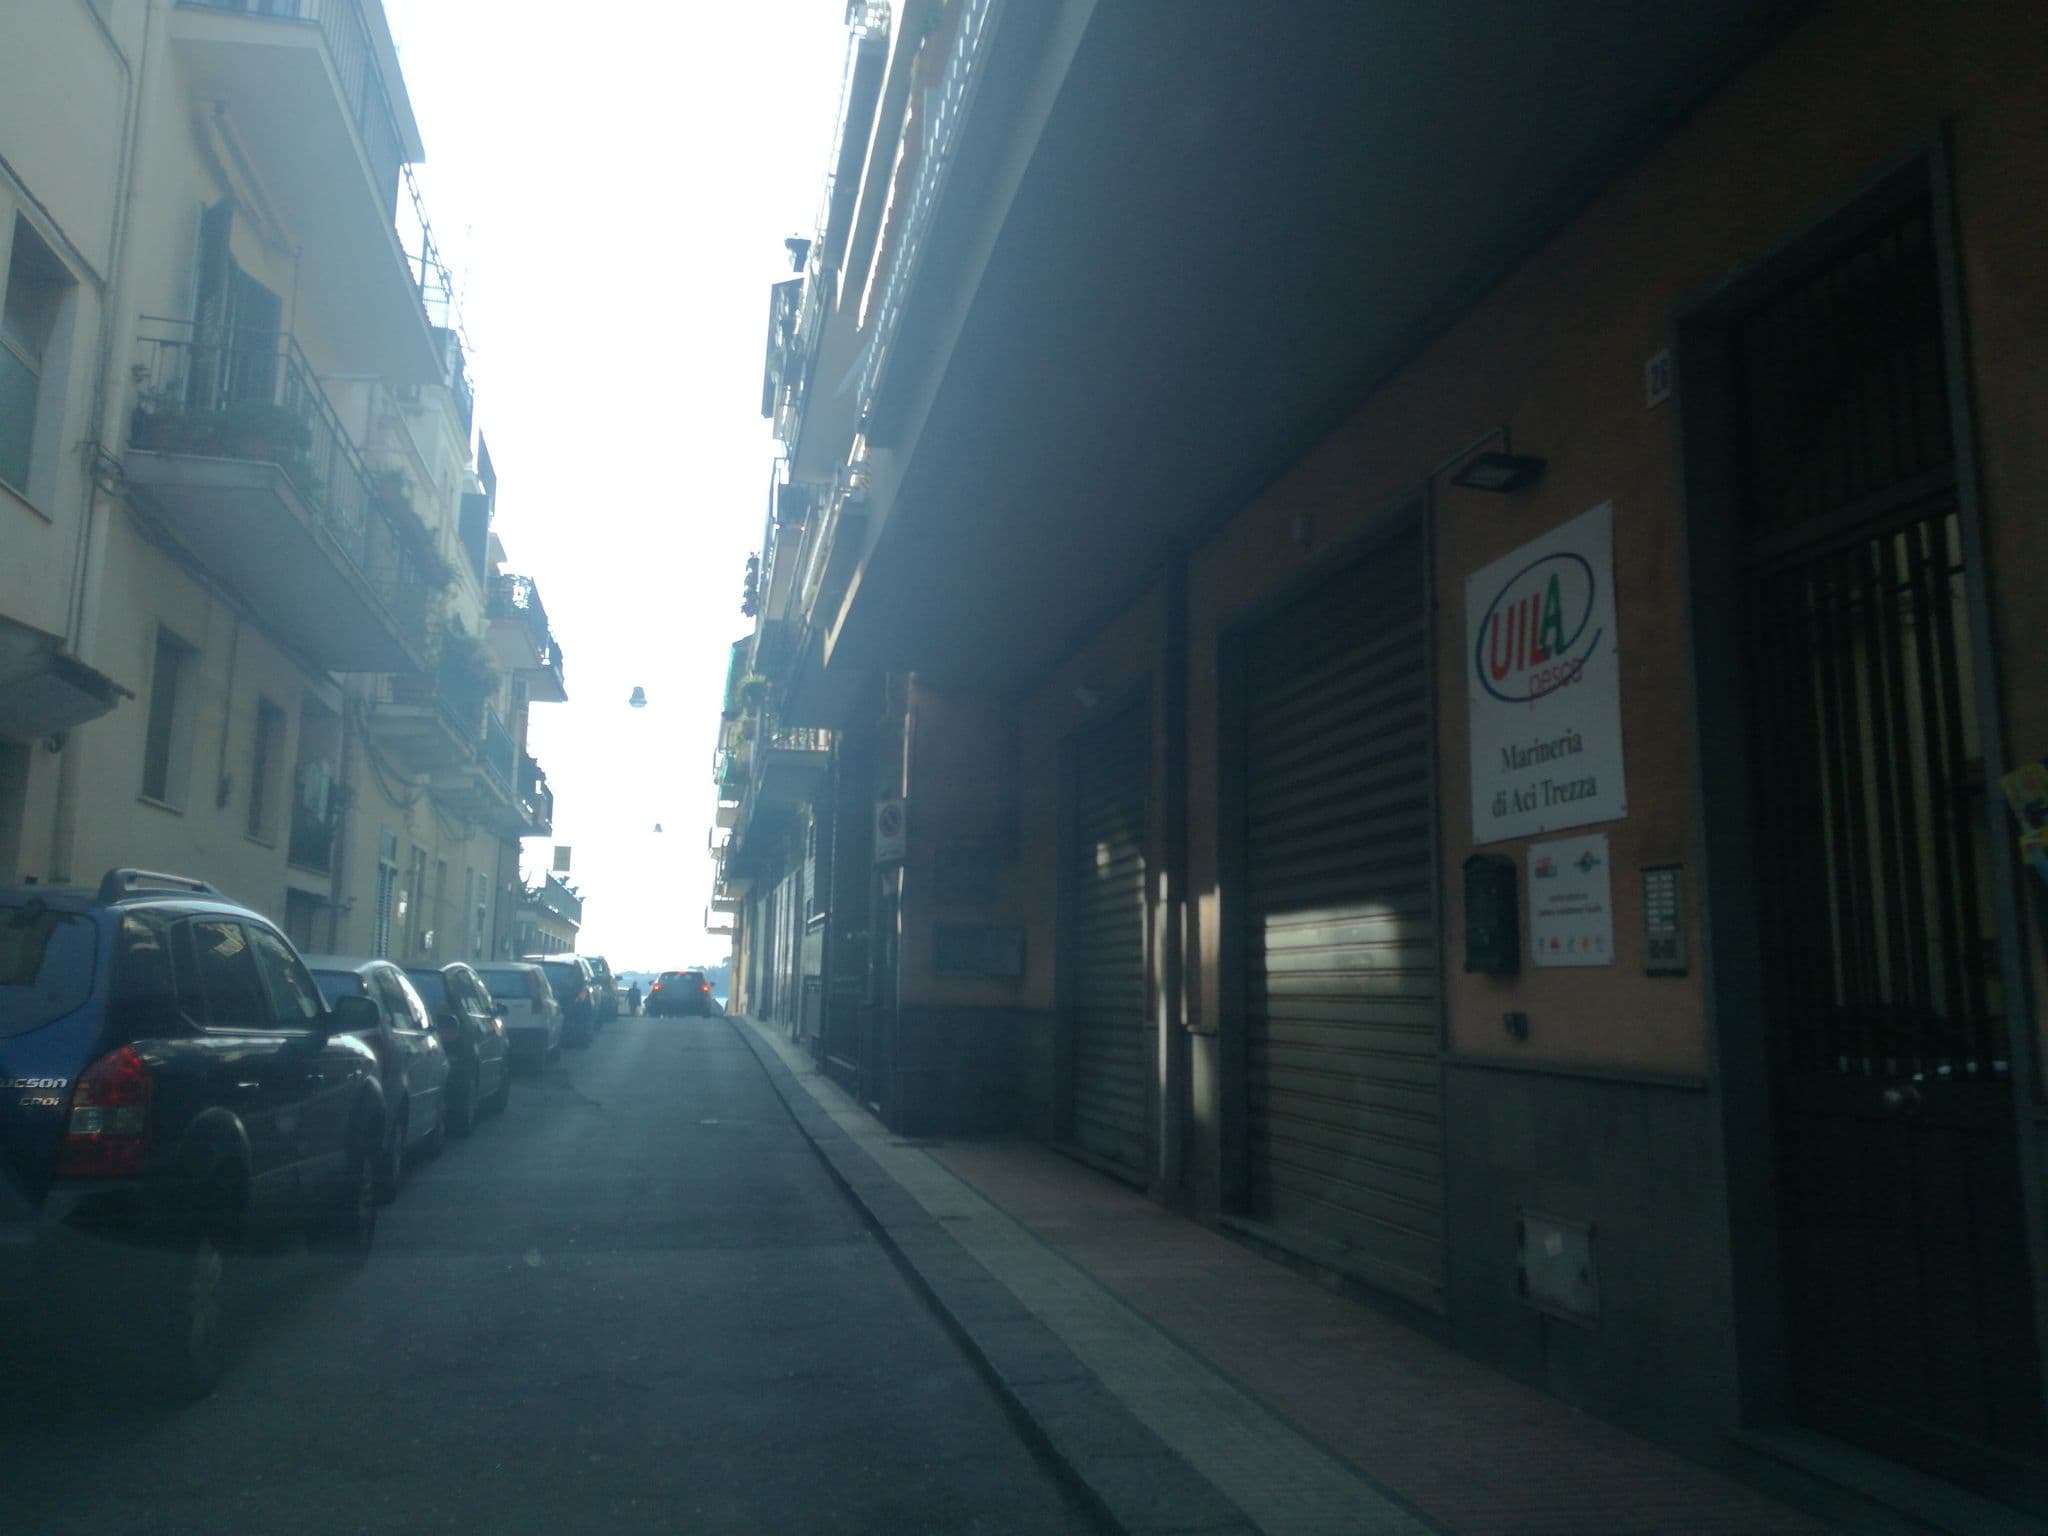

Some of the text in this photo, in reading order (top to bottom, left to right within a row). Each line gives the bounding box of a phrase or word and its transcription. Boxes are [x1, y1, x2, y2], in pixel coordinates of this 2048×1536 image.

[1489, 573, 1566, 681] UILA
[1528, 657, 1585, 711] pesca
[1500, 728, 1584, 774] Marineria
[1491, 775, 1598, 819] di Aci Trezza
